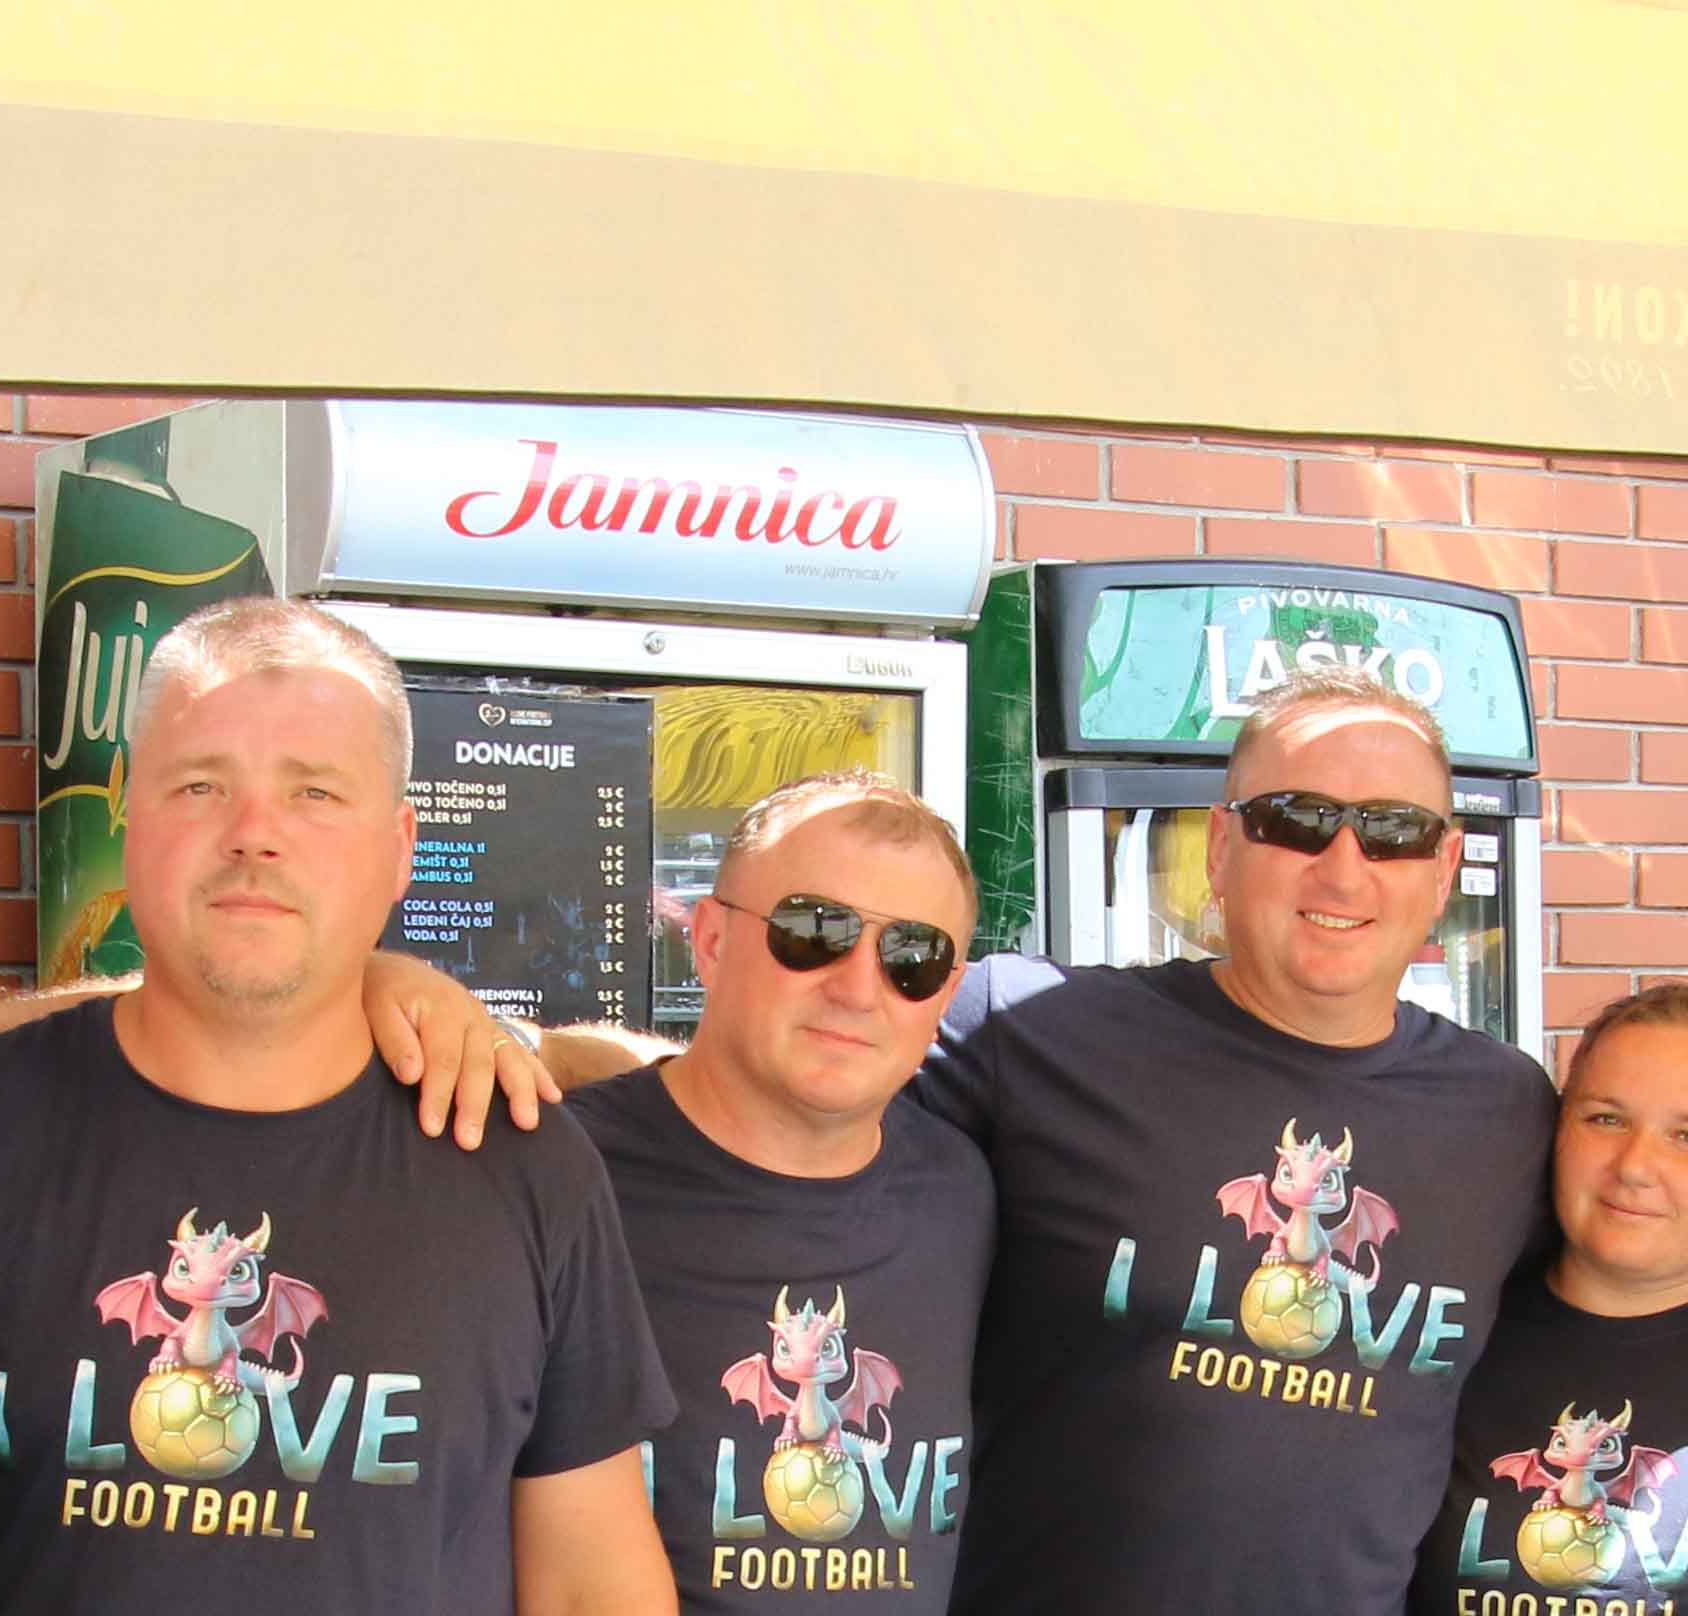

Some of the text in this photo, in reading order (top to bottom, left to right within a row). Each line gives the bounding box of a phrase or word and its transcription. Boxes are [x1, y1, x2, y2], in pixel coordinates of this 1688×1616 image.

[445, 438, 903, 553] Jamnica
[1238, 587, 1411, 625] PIVOVARNA
[455, 741, 575, 770] DONACIJE
[434, 779, 484, 795] TOČENO
[434, 795, 484, 809] TOČENO
[415, 841, 474, 853] INERALNA
[413, 854, 447, 867] EMIŠT
[411, 871, 451, 882] AMBUS
[403, 900, 437, 911] COCA
[439, 900, 472, 912] COLA
[404, 915, 448, 926] LEDENI
[450, 913, 471, 928] ČAJ
[403, 929, 437, 941] VODA
[1103, 1236, 1137, 1320] I
[1168, 1341, 1378, 1417] FOOTBALL
[61, 1478, 316, 1540] FOOTBALL
[712, 1546, 915, 1592] FOOTBALL
